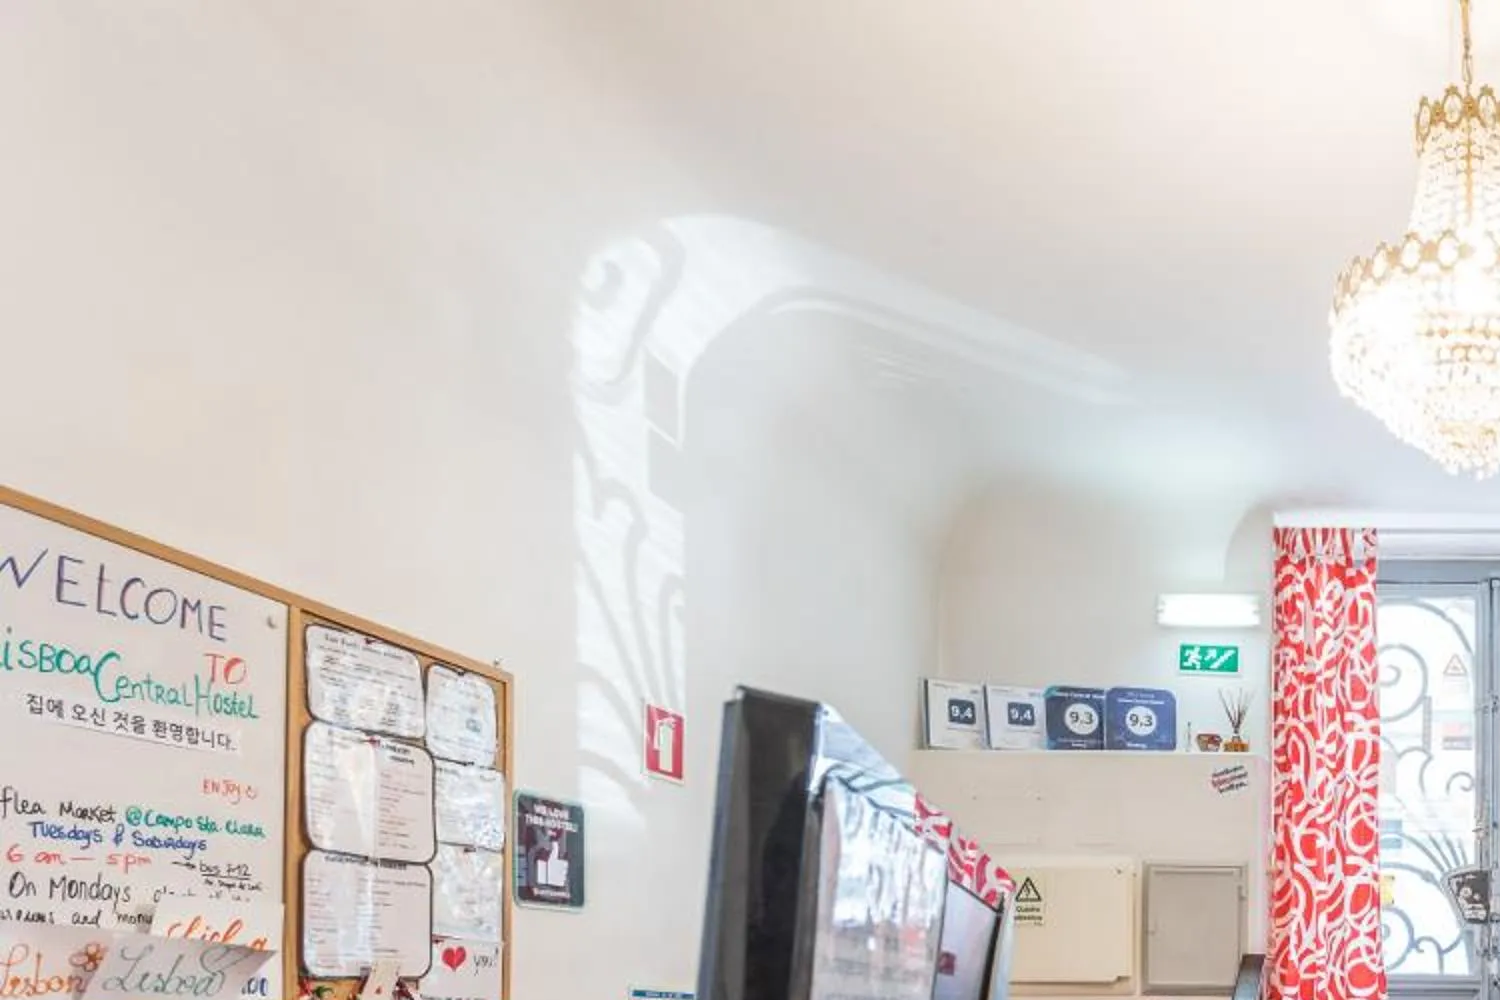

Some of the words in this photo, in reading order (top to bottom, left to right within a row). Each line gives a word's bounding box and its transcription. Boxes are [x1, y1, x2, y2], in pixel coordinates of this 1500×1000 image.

[0, 549, 228, 642] WELCOME
[204, 652, 248, 685] TO
[27, 820, 103, 850] Tuesdays
[9, 871, 37, 899] On
[49, 874, 131, 903] Mondays
